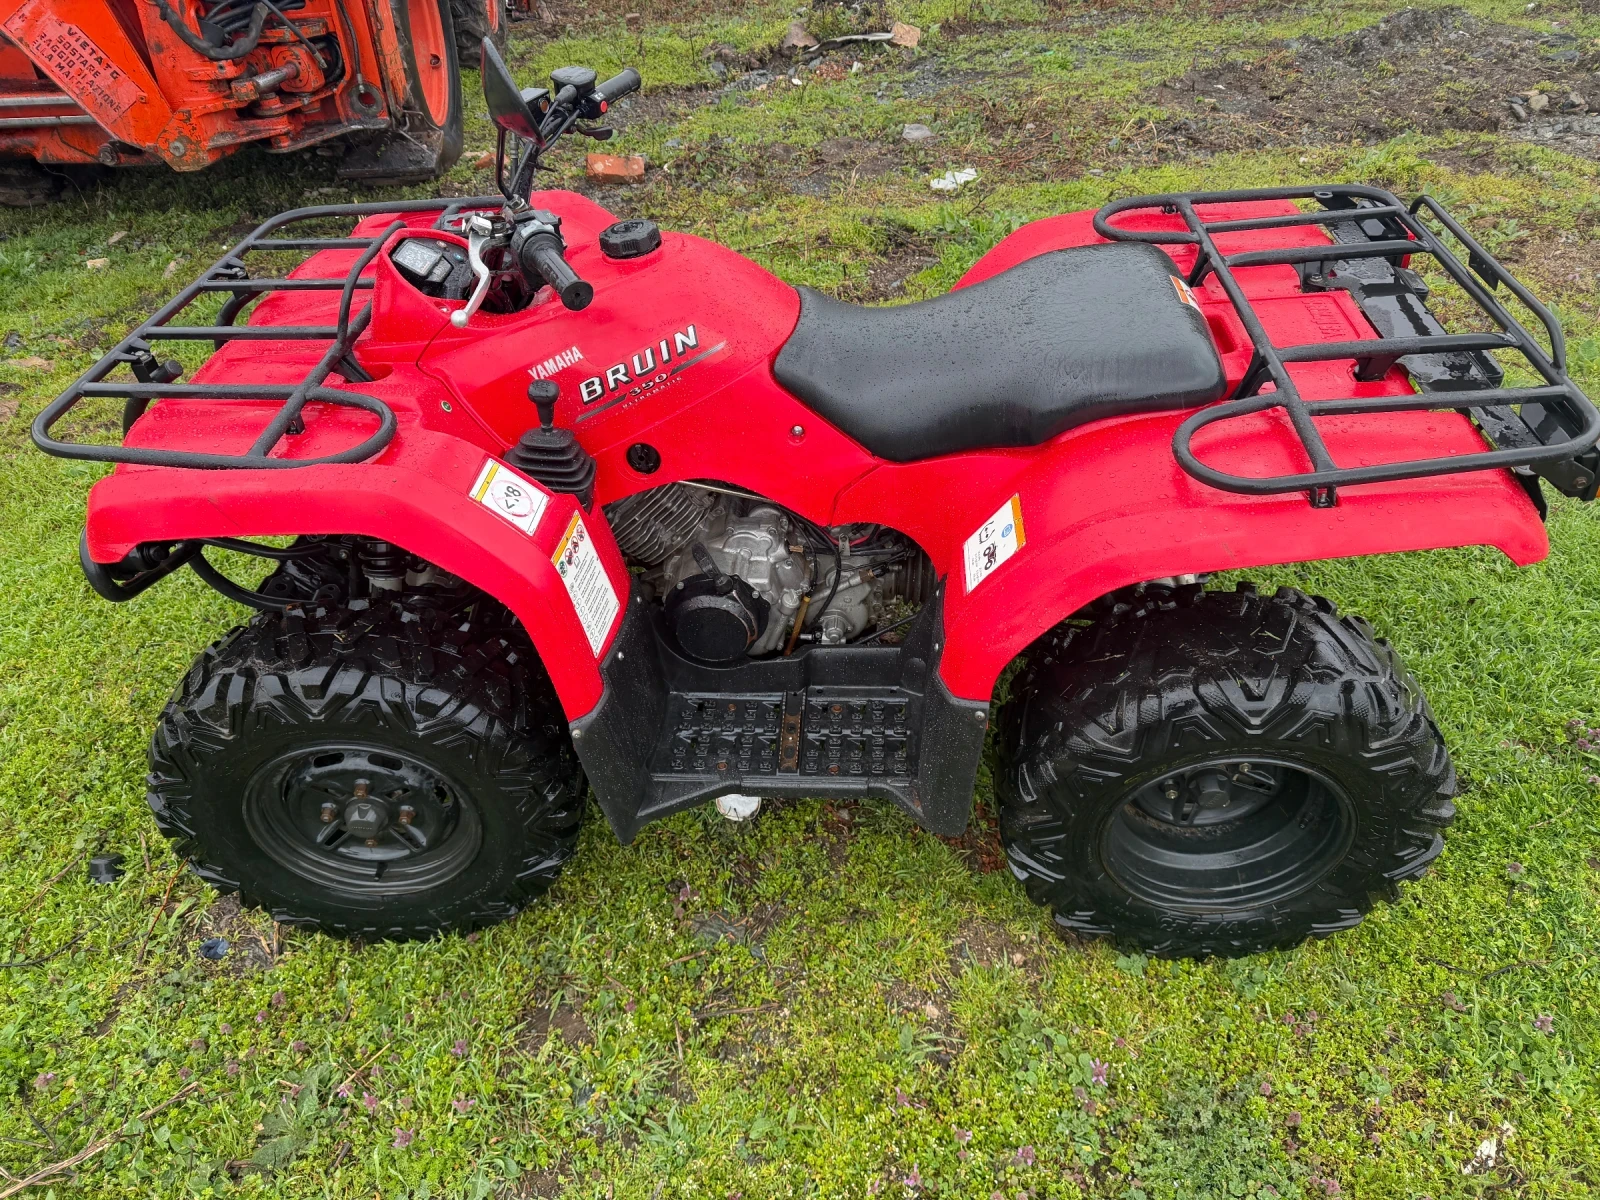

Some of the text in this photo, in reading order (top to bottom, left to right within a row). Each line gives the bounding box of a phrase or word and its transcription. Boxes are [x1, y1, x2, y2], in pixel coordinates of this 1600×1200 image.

[56, 34, 101, 78] SOSTARE
[66, 26, 121, 80] VIETATO
[527, 345, 584, 380] YAMAHA
[578, 324, 699, 405] BRUIN
[629, 373, 668, 396] 350
